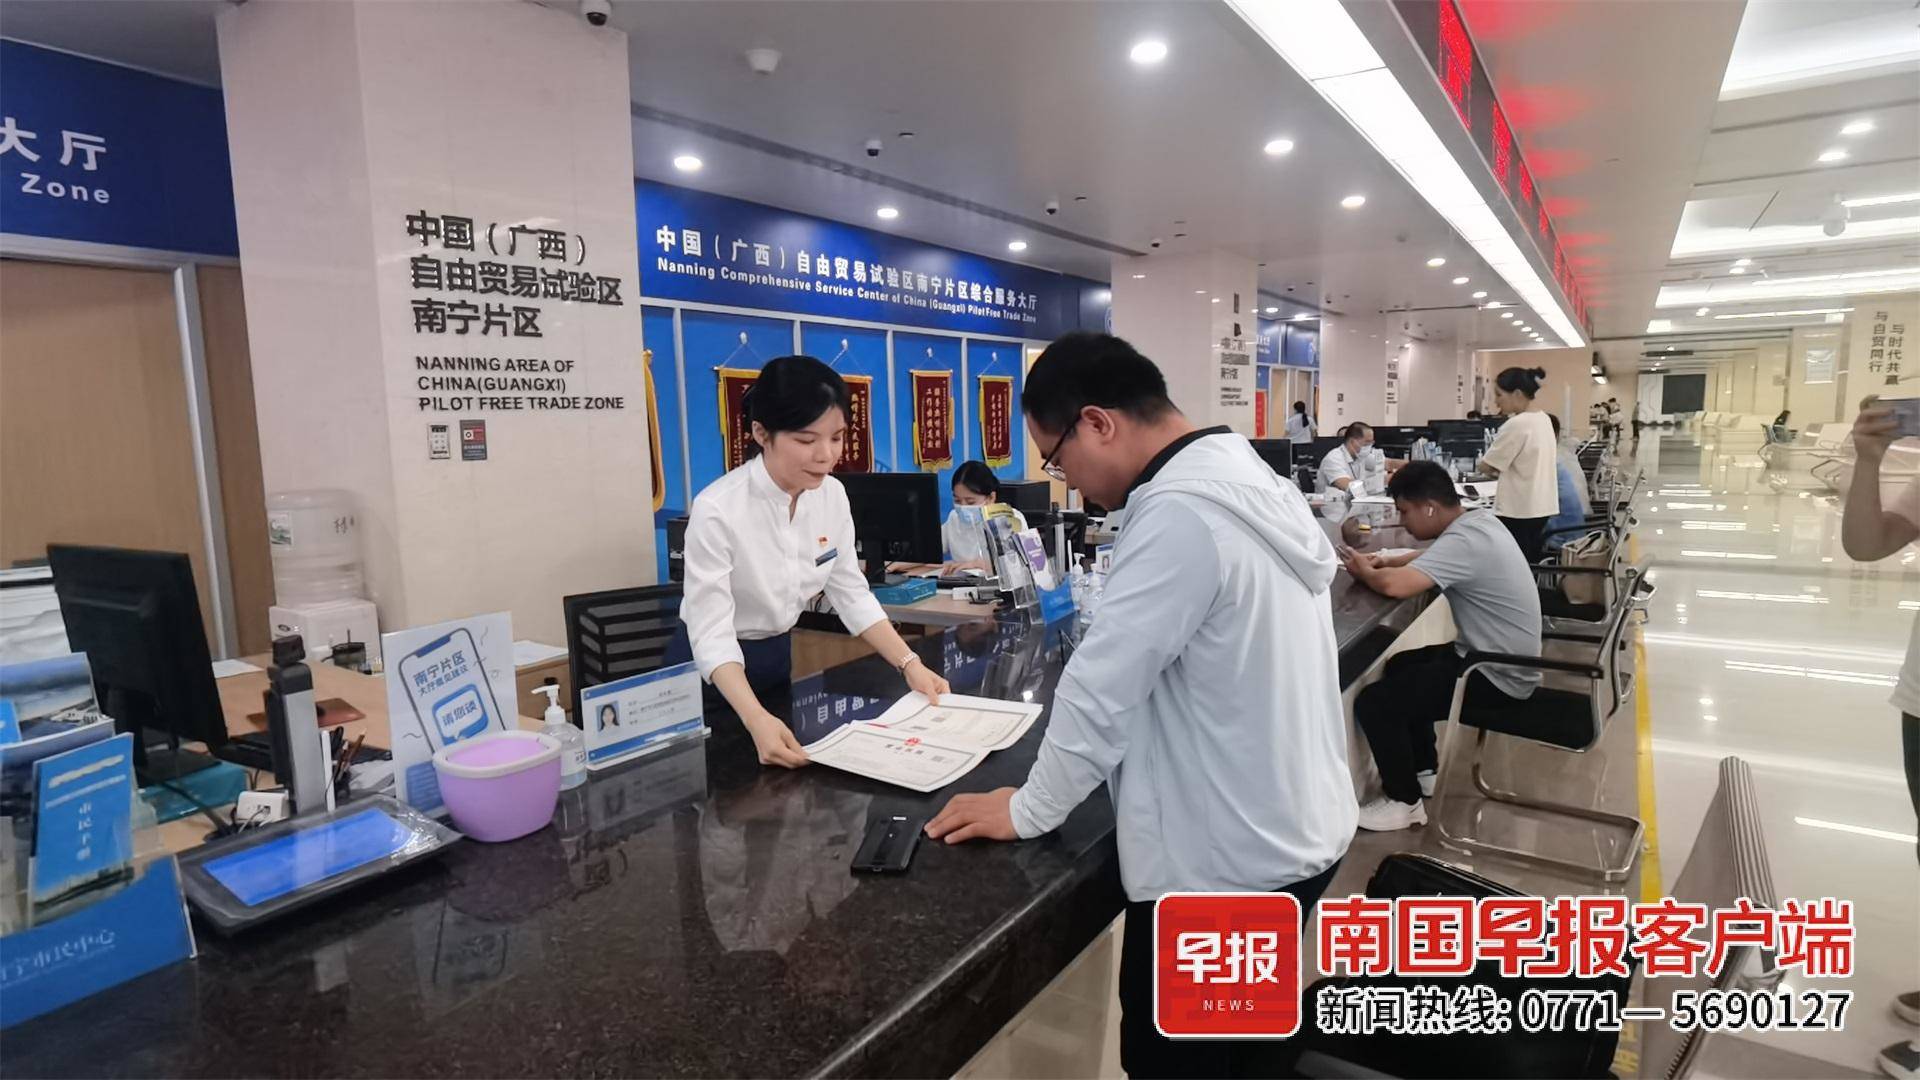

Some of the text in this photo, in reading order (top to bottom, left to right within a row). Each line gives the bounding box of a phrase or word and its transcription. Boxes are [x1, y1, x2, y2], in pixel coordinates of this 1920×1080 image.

[0, 116, 107, 171] 大厅
[20, 172, 110, 204] Zone
[410, 253, 624, 306] 自由贸易试验区
[657, 257, 716, 280] Nanning
[720, 266, 811, 291] Comprehensive
[815, 280, 854, 297] Service
[857, 286, 889, 302] Center
[891, 294, 901, 303] of
[903, 294, 927, 308] China
[929, 298, 966, 315] (Guangxi)
[411, 298, 543, 338] 南宁片区
[1869, 311, 1889, 373] 与自贸同行
[415, 356, 575, 373] NANNING AREA OF
[417, 376, 567, 394] CHINA(GUANGXI)
[418, 396, 625, 411] PILOT FREE TRADE ZONE
[413, 650, 467, 687] 南宁片区
